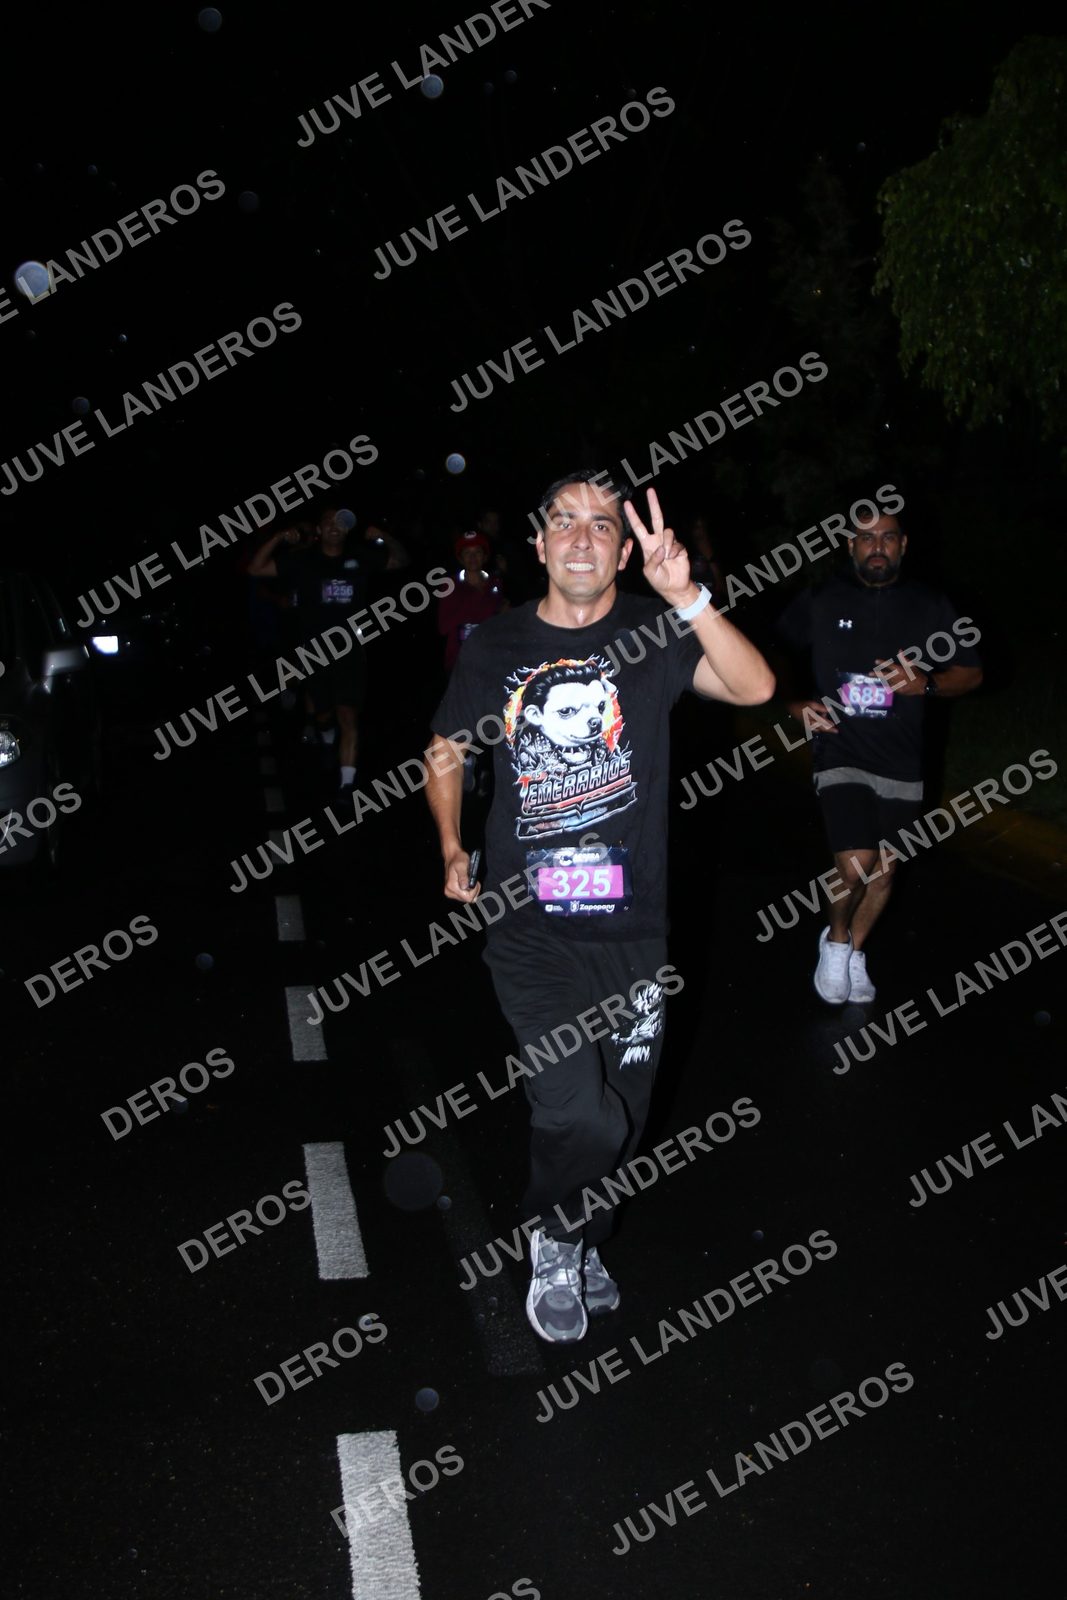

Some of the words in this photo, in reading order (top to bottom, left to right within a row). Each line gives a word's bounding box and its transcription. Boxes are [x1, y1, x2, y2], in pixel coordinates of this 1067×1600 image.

[849, 686, 886, 706] 685
[516, 751, 632, 812] TEMERARIOS
[552, 869, 611, 897] 325
